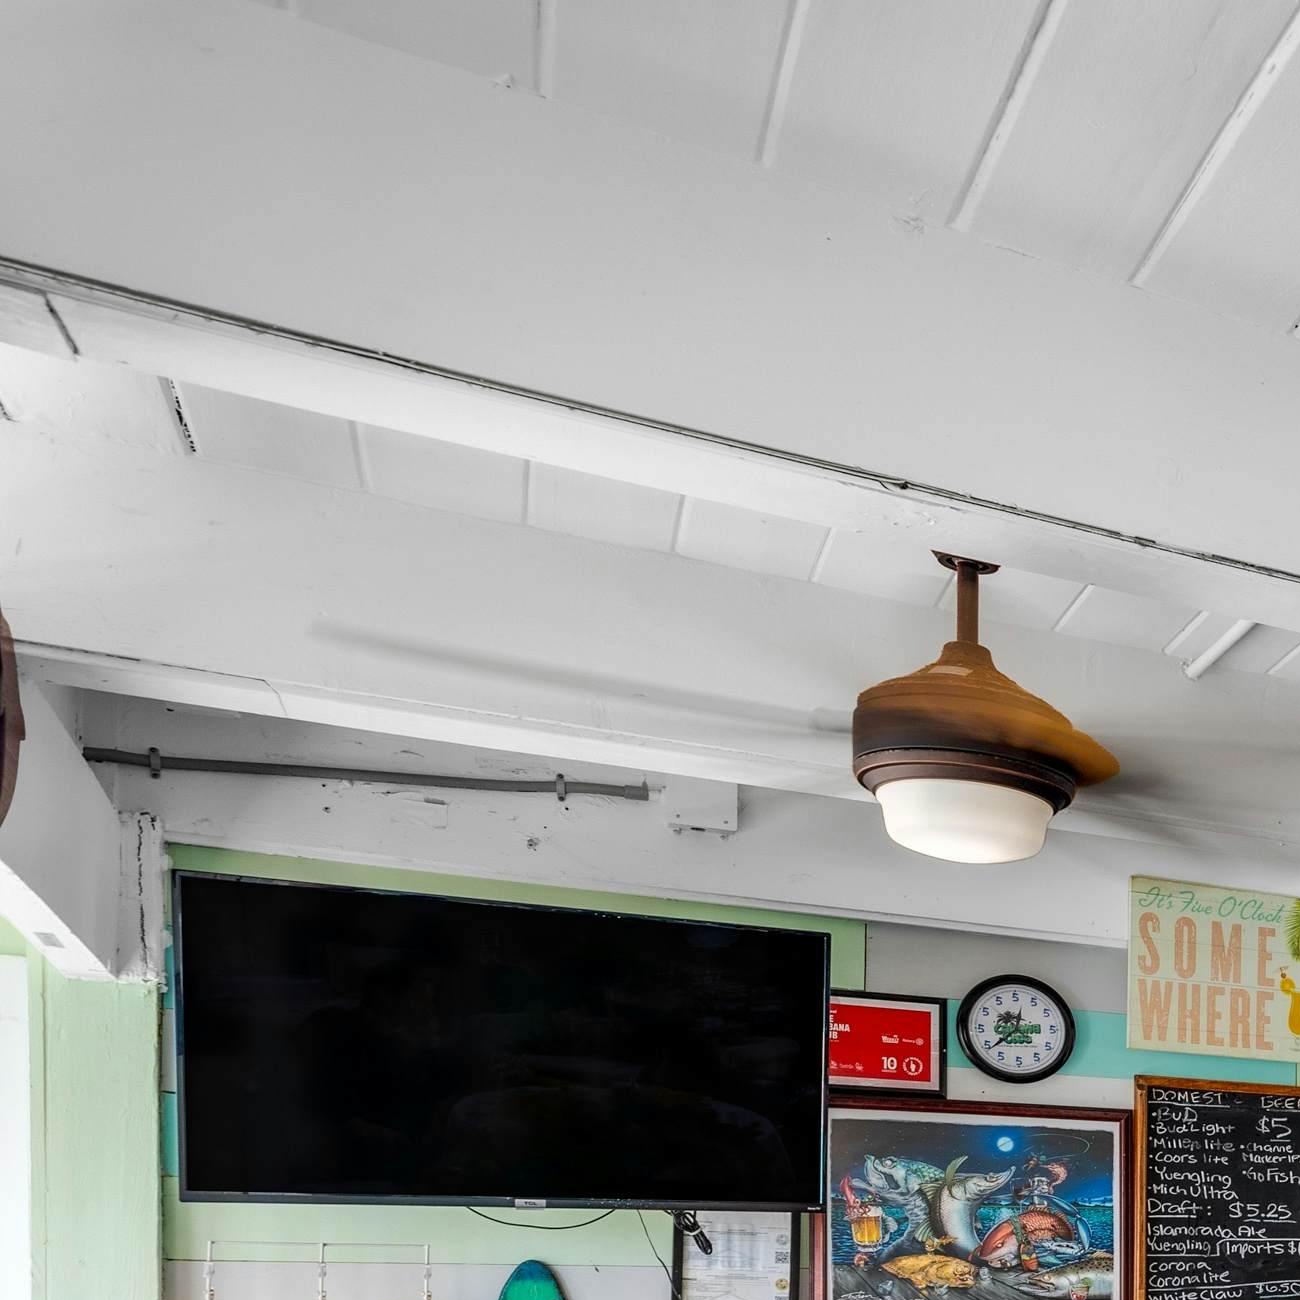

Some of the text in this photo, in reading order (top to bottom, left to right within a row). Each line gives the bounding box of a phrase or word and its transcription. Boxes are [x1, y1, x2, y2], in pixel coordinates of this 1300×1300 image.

[1138, 887, 1285, 923] It's Five O'Clock
[1137, 911, 1276, 987] SOME
[1137, 978, 1275, 1050] WHERE
[882, 1056, 897, 1070] 10
[1155, 1152, 1229, 1165] Coors lite
[1154, 1166, 1232, 1189] Yuengling
[1266, 1168, 1300, 1185] Fish
[1153, 1184, 1239, 1200] Mich Ultra
[1229, 1202, 1292, 1219] $5.25
[1148, 1222, 1268, 1238] Islamorada Ale
[1147, 1237, 1211, 1257] Yuengling
[1226, 1242, 1284, 1259] Imports
